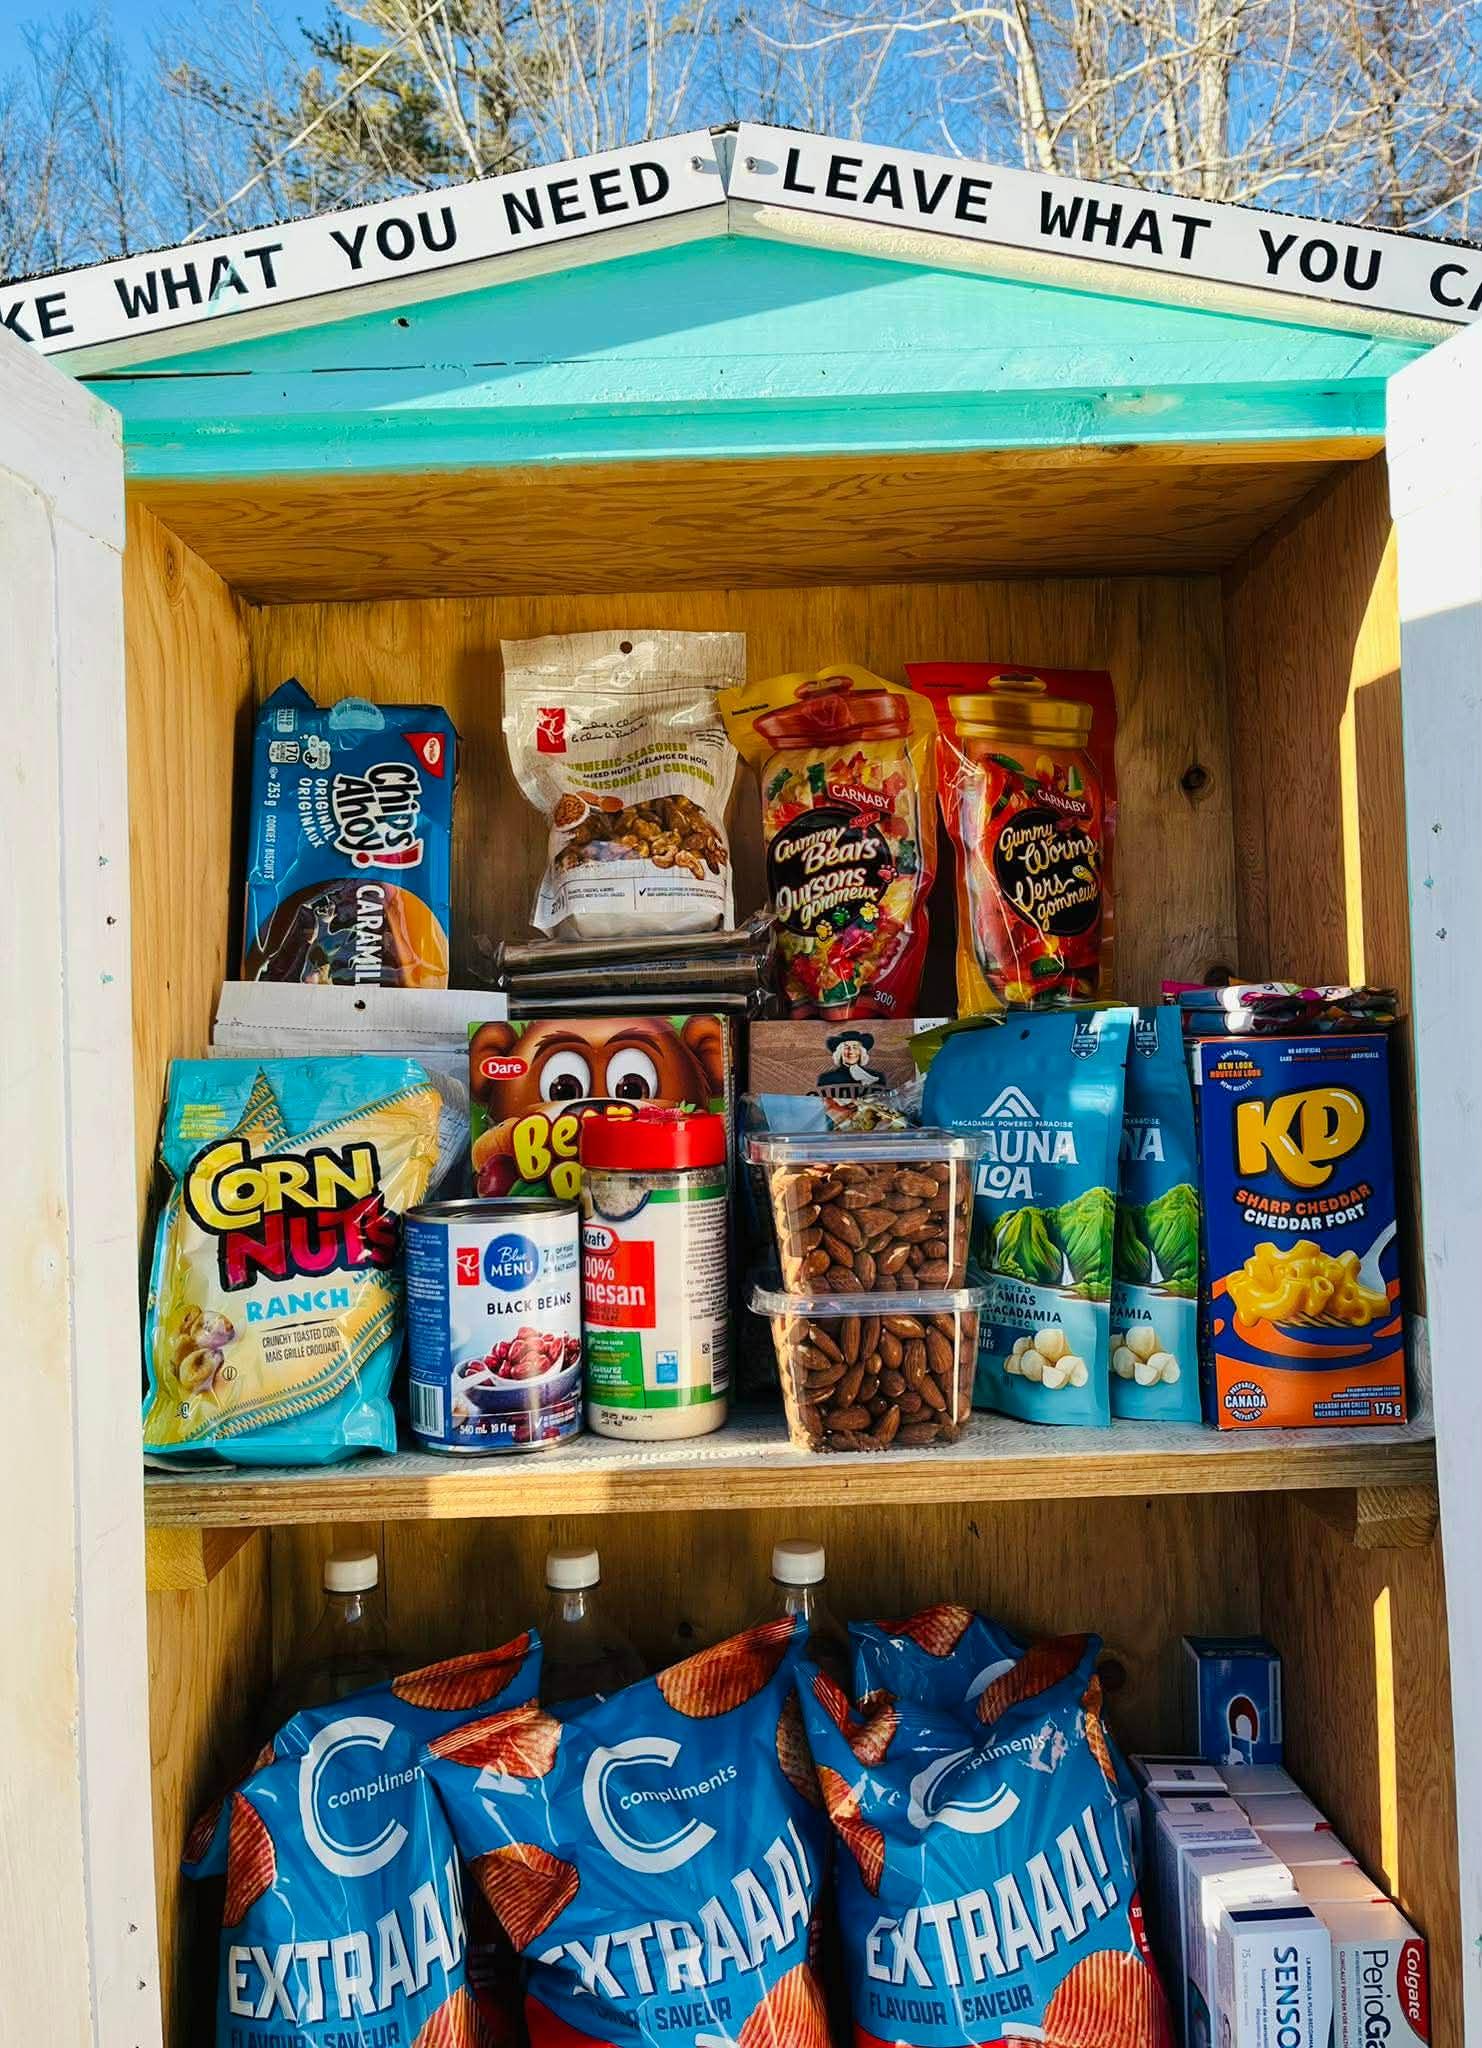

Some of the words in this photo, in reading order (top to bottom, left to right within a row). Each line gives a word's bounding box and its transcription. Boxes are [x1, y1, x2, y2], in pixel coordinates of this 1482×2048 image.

[783, 147, 994, 224] LEAVE
[1040, 191, 1212, 260] WHAT
[1258, 229, 1384, 293] YOU
[0, 290, 75, 342] KE
[114, 243, 285, 321] WHAT
[329, 205, 458, 271] YOU
[502, 160, 671, 236] NEED
[267, 781, 281, 801] 253
[366, 762, 421, 850] Chips
[832, 784, 890, 809] CARNABY
[1037, 790, 1087, 813] CARNABY
[297, 777, 326, 849] ORIGINAUX
[314, 778, 338, 842] ORIGINAL
[775, 826, 847, 864] Gummy
[802, 835, 881, 875] Bears
[999, 823, 1057, 861] Gummy
[1017, 838, 1099, 875] Worms
[775, 868, 867, 916] Oursons
[800, 886, 879, 930] gommeux
[1014, 876, 1075, 913] Vers
[1037, 883, 1099, 933] gommeux
[487, 1061, 522, 1075] Dare
[1235, 1061, 1253, 1069] LOOK
[997, 1120, 1033, 1128] POWERED
[1236, 1087, 1366, 1188] KD
[982, 1130, 1079, 1165] AUNA
[188, 1143, 375, 1231] CORN
[975, 1164, 1034, 1200] LOA
[1235, 1187, 1292, 1215] SHARP
[1296, 1184, 1372, 1215] CHEDDAR
[1244, 1208, 1323, 1231] CHEDDAR
[1326, 1203, 1366, 1229] FORT
[226, 1197, 397, 1288] NUTS
[498, 1246, 527, 1264] Blue
[490, 1262, 534, 1277] MENU
[584, 1256, 616, 1281] 00%
[245, 1287, 350, 1323] RANCH
[487, 1298, 532, 1315] BLACK
[538, 1293, 573, 1311] BEANS
[585, 1282, 646, 1306] mesan
[262, 1333, 291, 1348] CRUNCHY
[293, 1328, 321, 1343] TOASTED
[306, 1340, 340, 1356] CROQUANT
[1225, 1395, 1267, 1408] CANADA
[1374, 1402, 1393, 1415] 175
[1394, 1405, 1401, 1417] g
[962, 1733, 1046, 1775] pliments
[619, 1763, 738, 1811] compliments
[866, 1806, 1119, 1988] EXTRAAA!
[1241, 1948, 1251, 1958] 75
[1406, 1947, 1421, 2019] Colgate
[654, 1997, 732, 2031] SAVEUR
[869, 1991, 949, 2026] FLAVOUR
[962, 1984, 1034, 2022] SAVEUR
